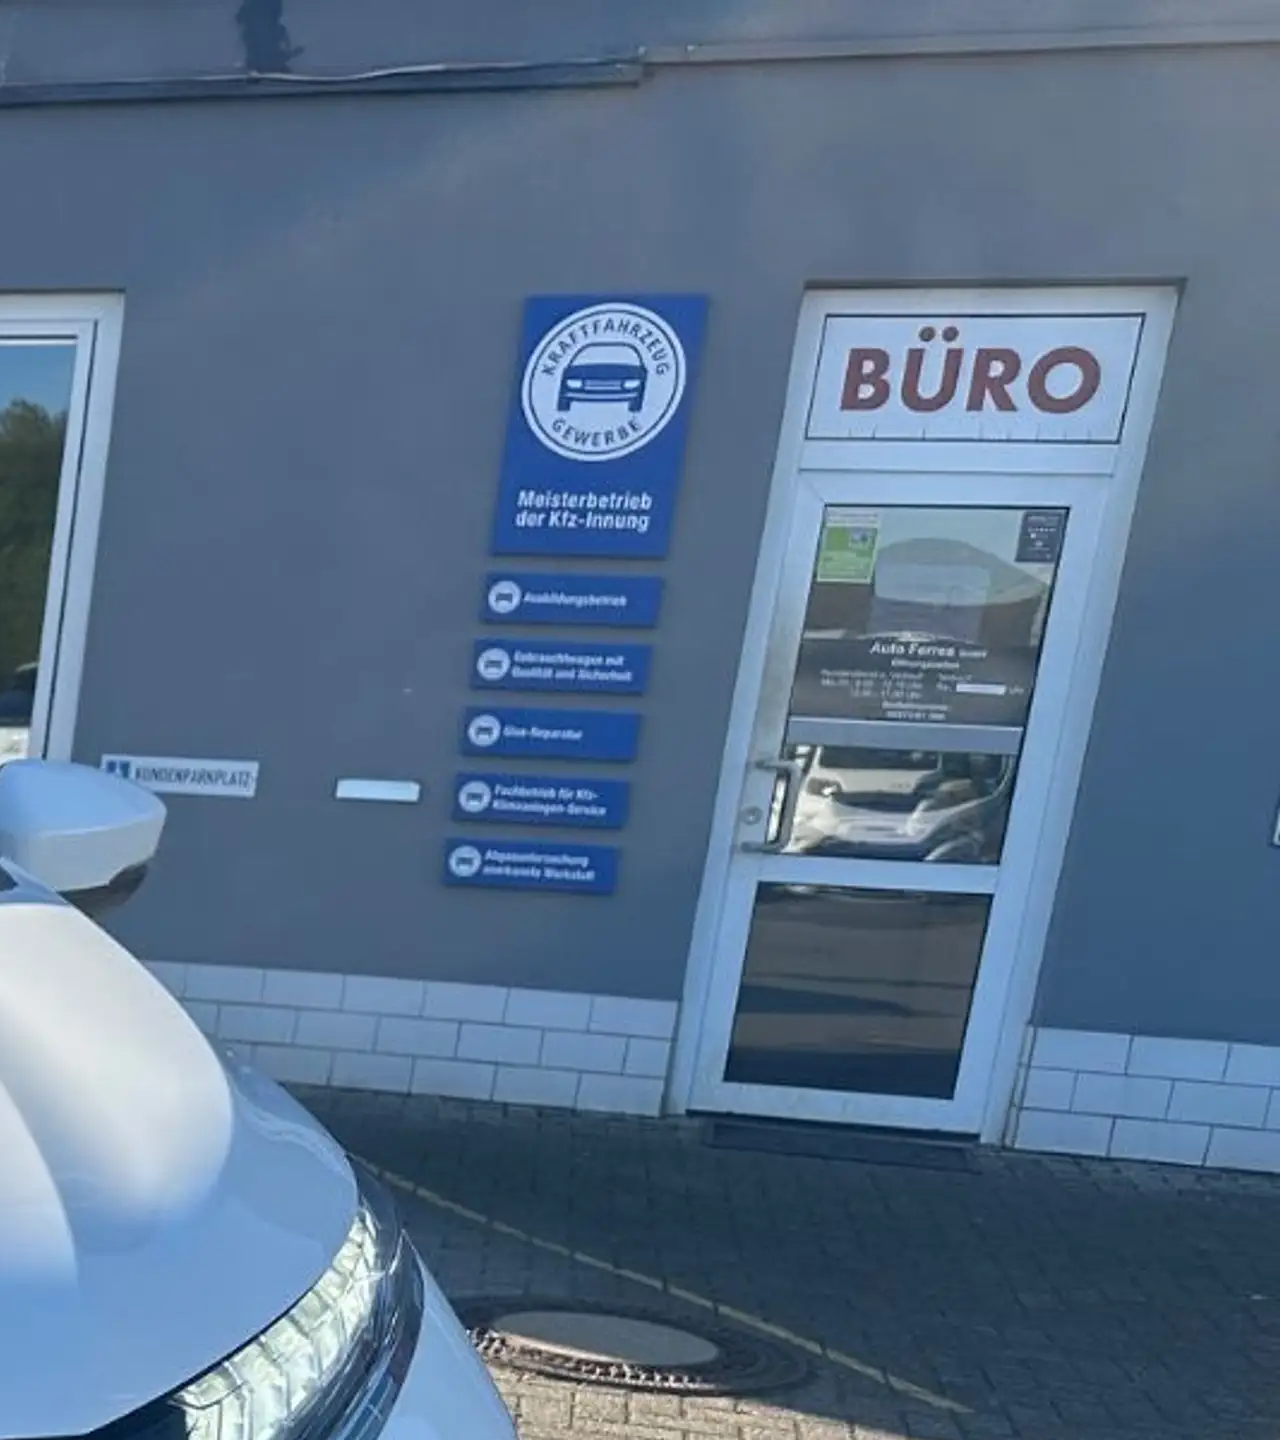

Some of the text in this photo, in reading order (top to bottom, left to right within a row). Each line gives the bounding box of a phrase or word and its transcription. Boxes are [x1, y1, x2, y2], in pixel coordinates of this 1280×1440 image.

[541, 318, 670, 376] KRAFTFAHRZEUG
[839, 325, 1101, 414] BÜRO
[552, 417, 640, 448] GEWERBE
[517, 489, 652, 510] Meisterbetrieb
[516, 510, 650, 534] der Kfz-Innung
[870, 640, 904, 656] Auto
